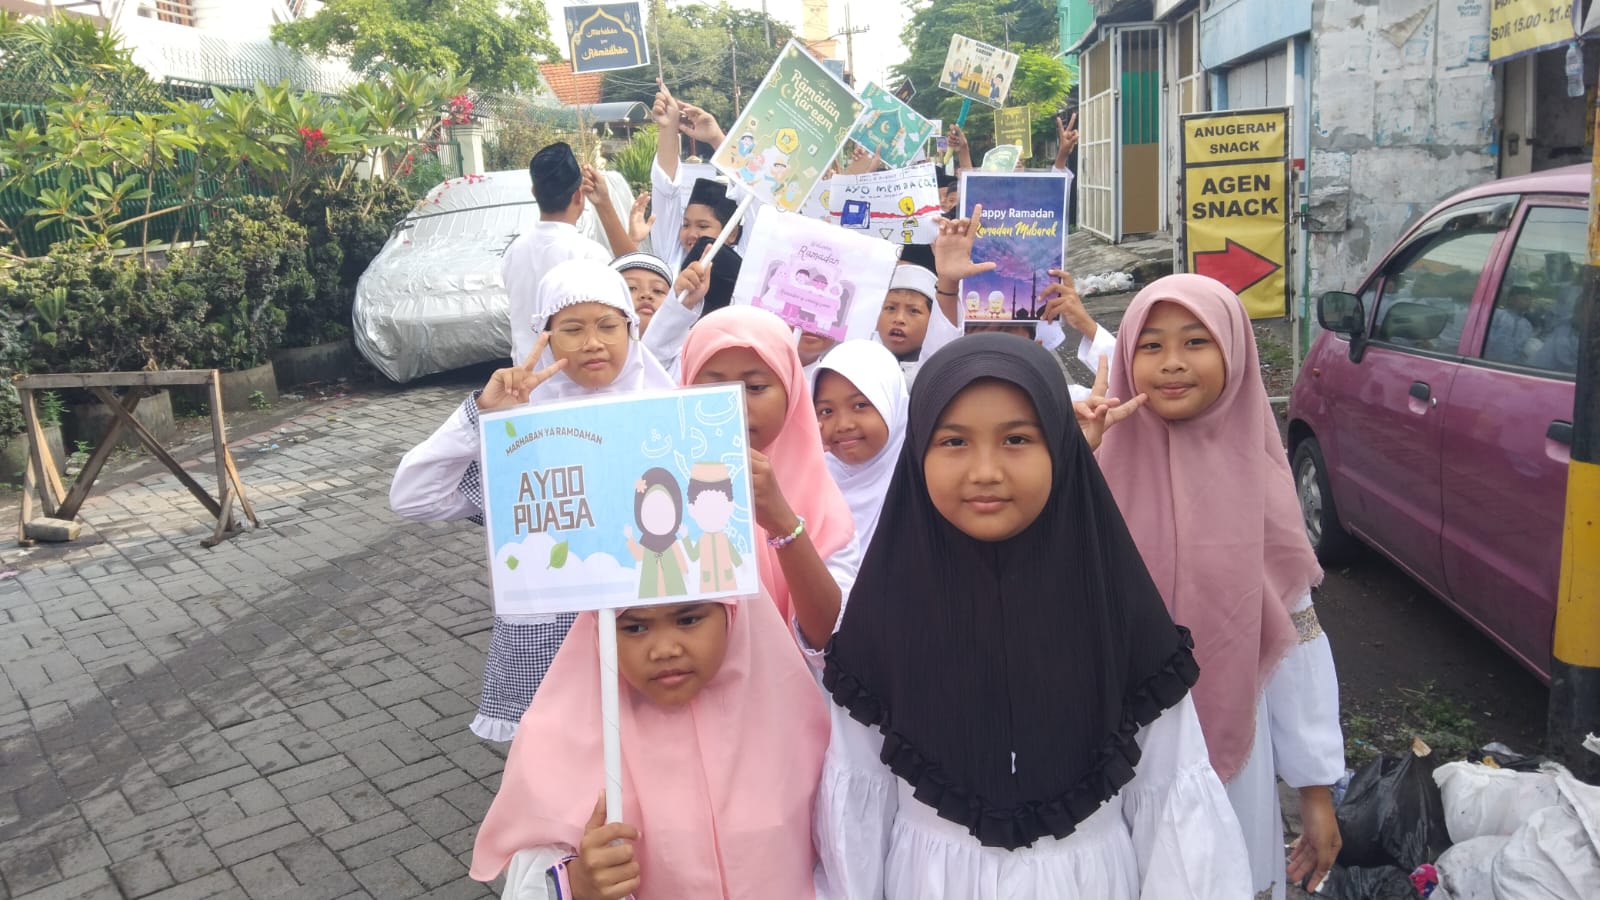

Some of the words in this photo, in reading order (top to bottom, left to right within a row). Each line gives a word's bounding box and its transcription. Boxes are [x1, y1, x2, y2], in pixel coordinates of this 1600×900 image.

[1194, 122, 1276, 138] ANUGERAH
[1209, 141, 1260, 154] SNACK
[1201, 174, 1270, 195] AGEN
[979, 208, 1007, 220] appy
[1008, 207, 1054, 218] Ramadan
[1192, 197, 1279, 220] SNACK
[1015, 221, 1058, 239] Mubarak
[799, 245, 839, 264] Ramadan
[505, 429, 544, 456] MARHABAN
[544, 427, 555, 437] YA
[555, 427, 603, 445] RAMDAHAN
[513, 497, 595, 535] PUASA
